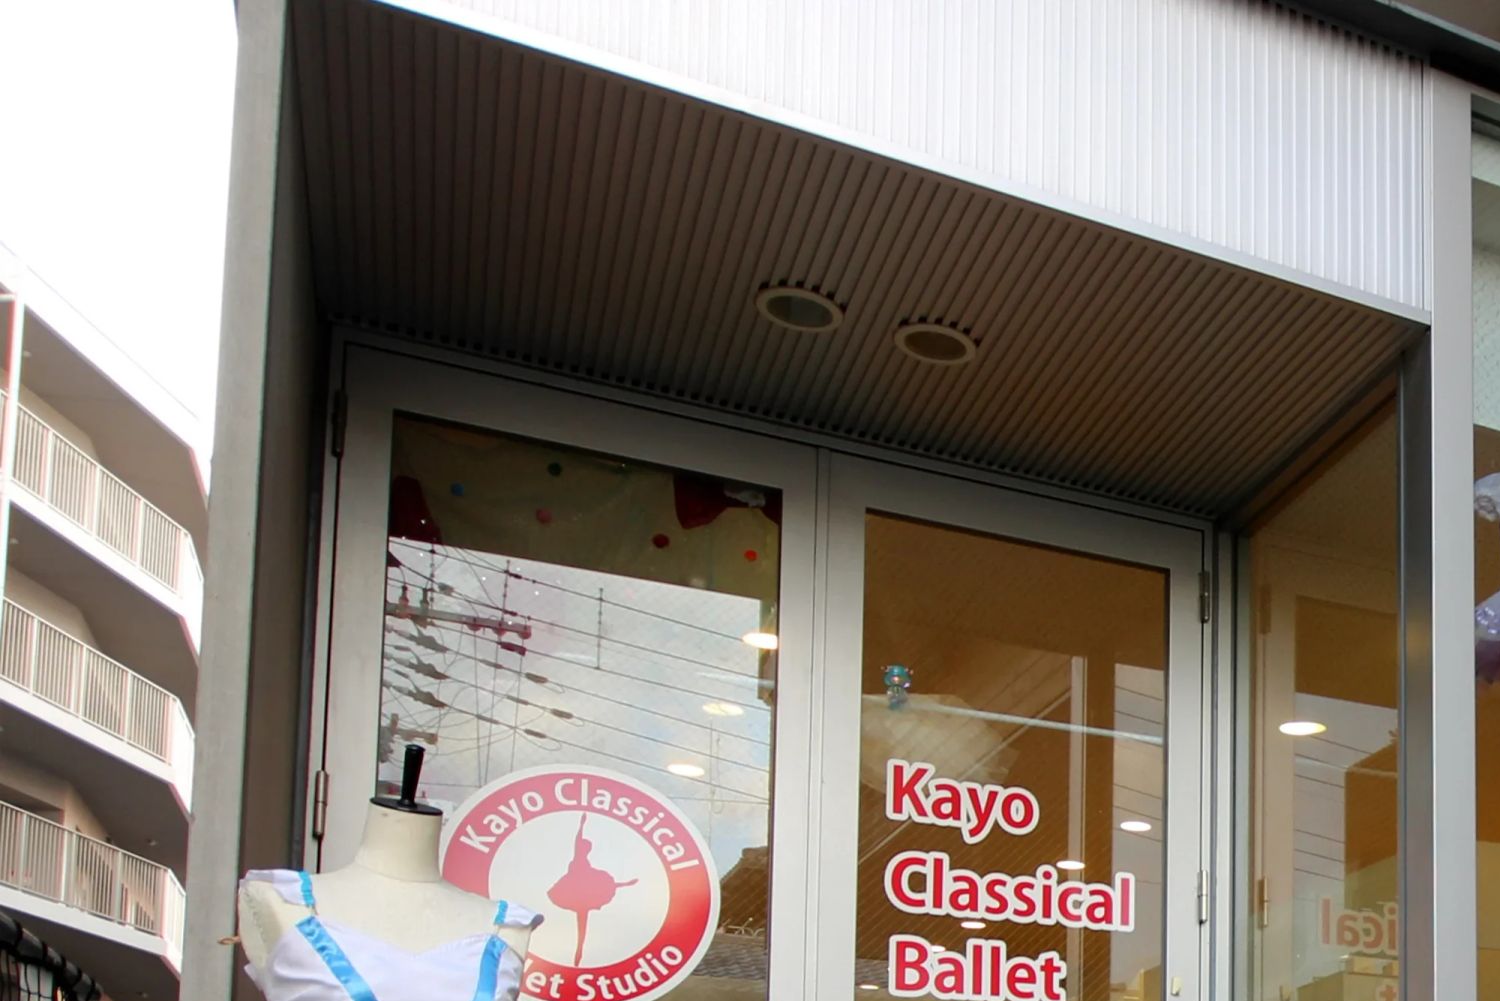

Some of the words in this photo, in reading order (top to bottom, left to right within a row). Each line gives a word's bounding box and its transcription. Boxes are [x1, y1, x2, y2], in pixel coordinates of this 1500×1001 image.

[458, 789, 545, 855] Kayo
[553, 777, 701, 872] Classical
[892, 764, 1035, 838] Kayo
[890, 856, 1131, 928] Classical
[894, 940, 1062, 1001] Ballet
